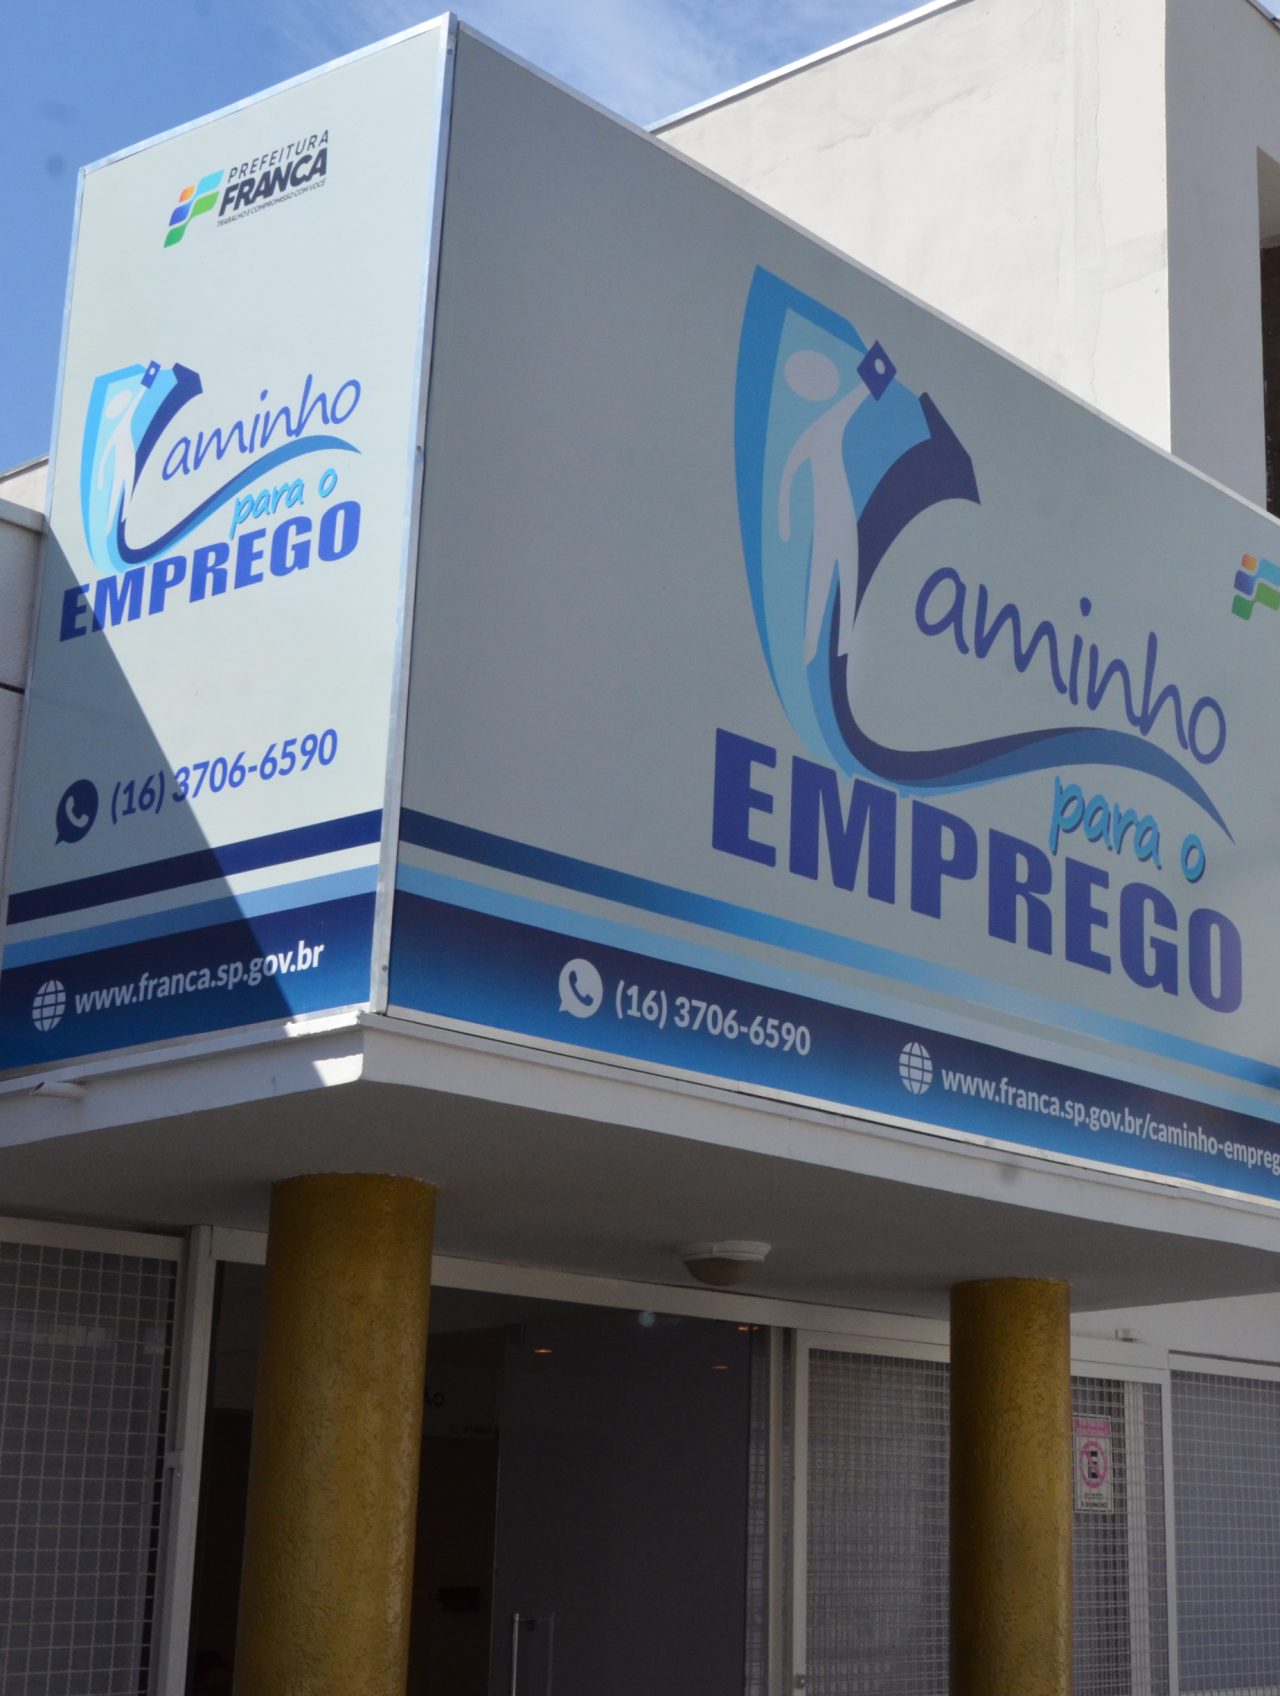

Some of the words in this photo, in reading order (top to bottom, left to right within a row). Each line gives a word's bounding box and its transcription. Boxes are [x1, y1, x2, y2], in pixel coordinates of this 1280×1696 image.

[219, 147, 328, 217] FRANCA
[228, 129, 328, 183] PREFEITURA
[229, 478, 304, 540] para
[318, 468, 338, 498] o
[59, 500, 361, 642] EMPREGO
[111, 771, 166, 825] (16)
[172, 728, 339, 803] 3706-6590
[1049, 775, 1162, 870] para
[1180, 833, 1206, 883] o
[711, 727, 1243, 1014] EMPREGO
[75, 940, 324, 1015] www.franca.sp.gov.br
[615, 980, 668, 1030] (16)
[674, 996, 811, 1056] 3706-6590
